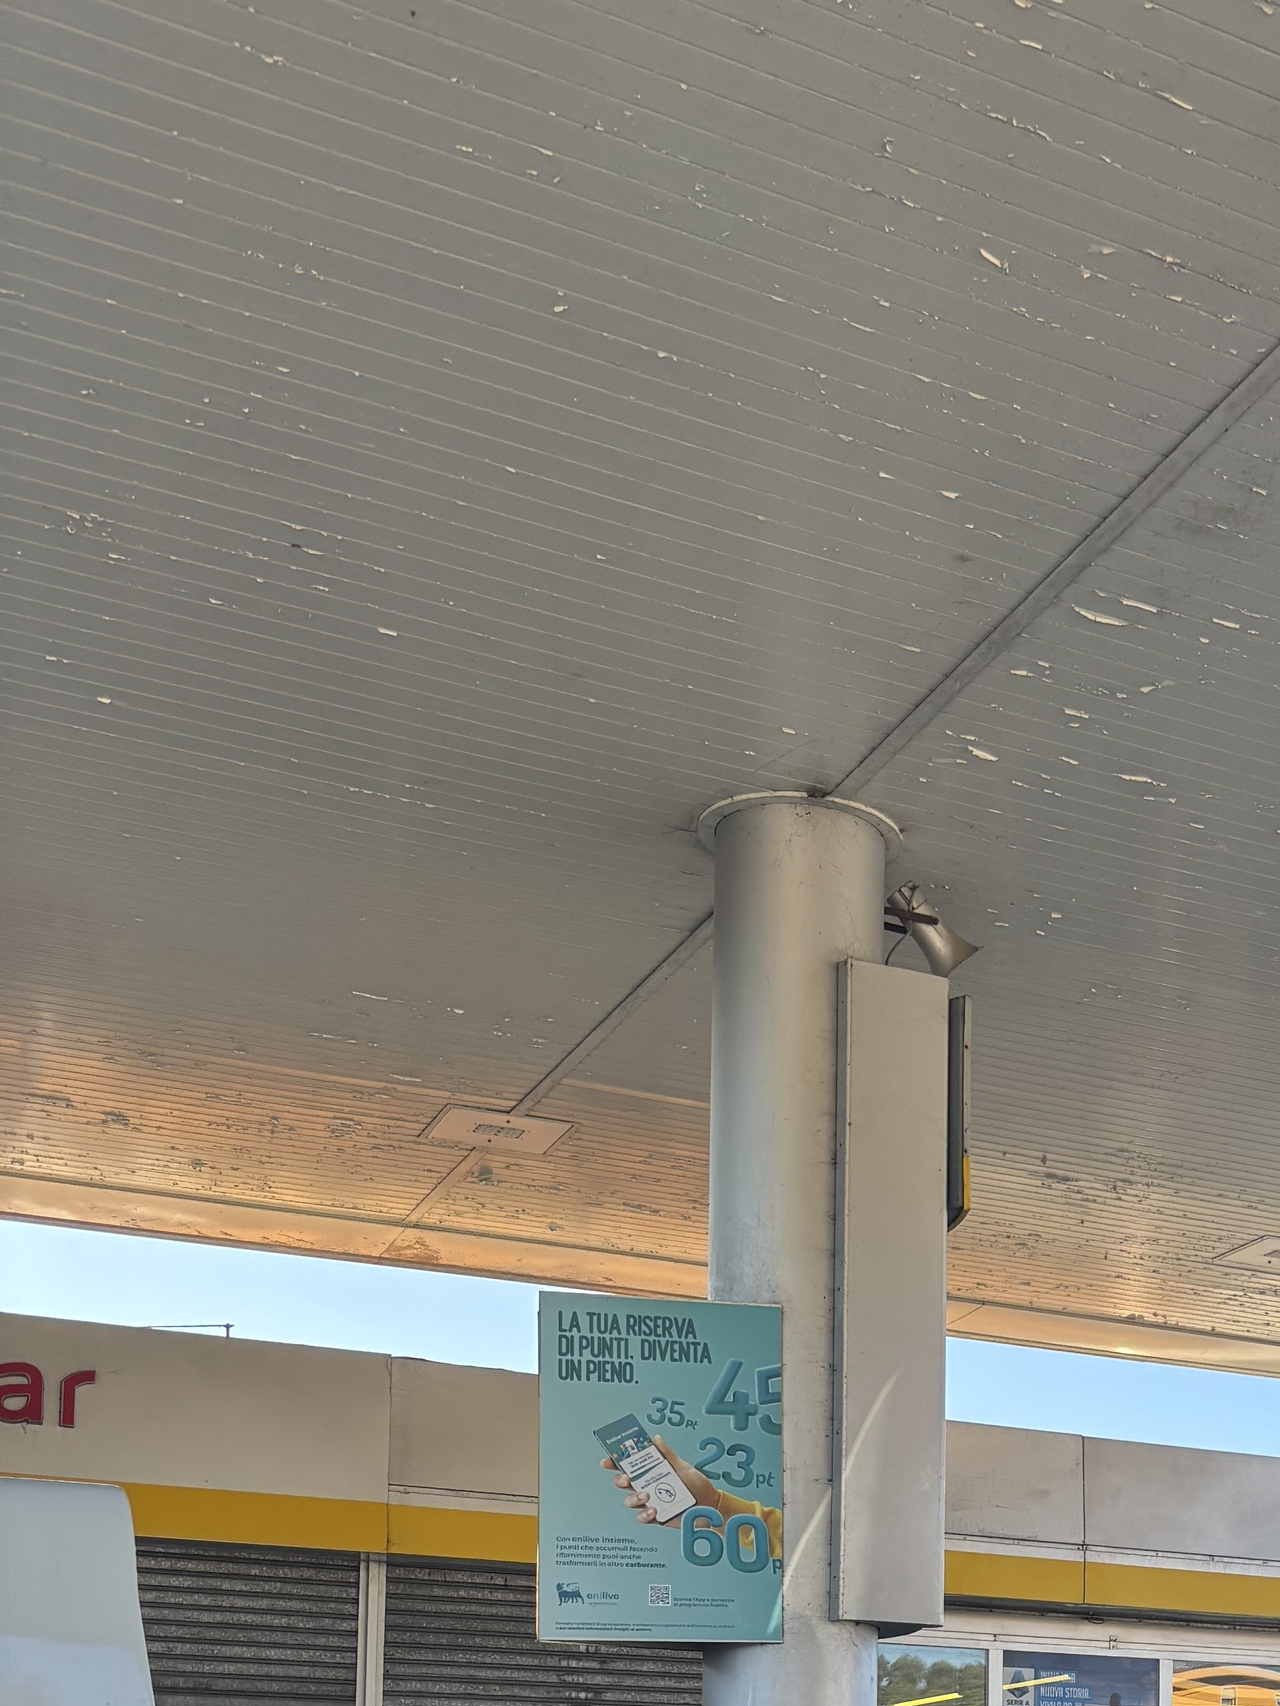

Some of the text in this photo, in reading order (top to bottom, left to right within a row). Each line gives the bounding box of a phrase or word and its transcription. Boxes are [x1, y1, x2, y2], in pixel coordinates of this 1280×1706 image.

[558, 1310, 697, 1339] LA TUA RISERVA
[558, 1335, 574, 1357] DI
[640, 1339, 712, 1364] DIVENTA
[558, 1359, 639, 1385] UN PIENO.
[560, 1544, 580, 1552] punti
[1040, 1687, 1063, 1698] NUOVA
